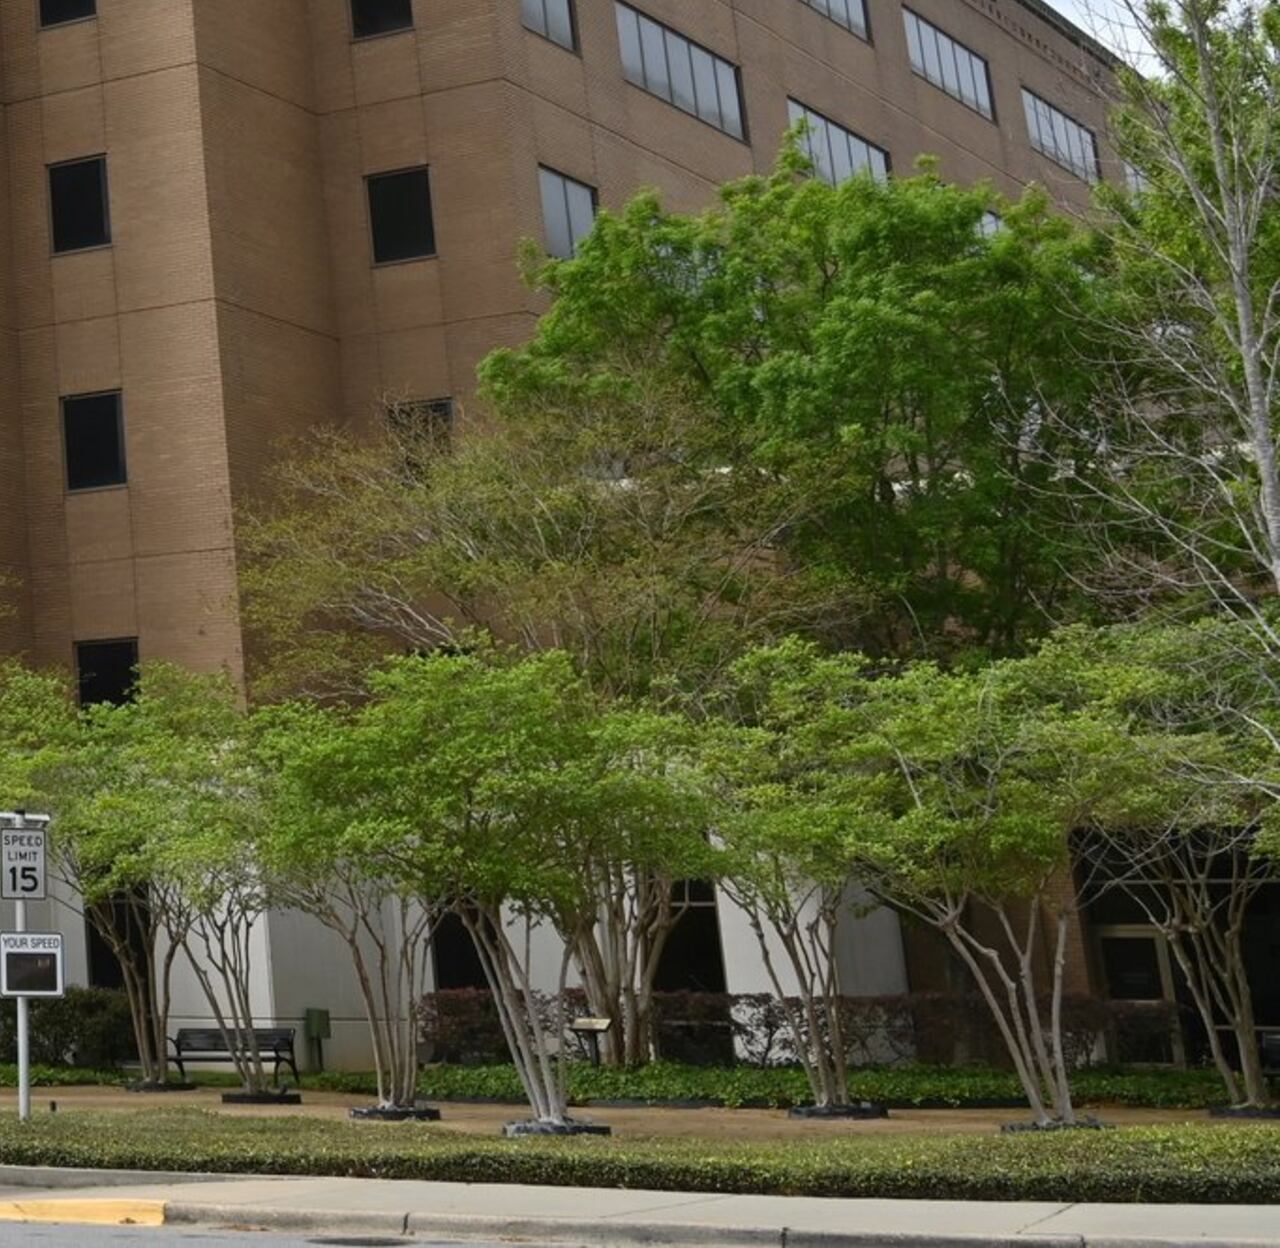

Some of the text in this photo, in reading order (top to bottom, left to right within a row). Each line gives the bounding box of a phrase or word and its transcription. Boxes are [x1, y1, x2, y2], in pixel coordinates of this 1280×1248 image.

[4, 835, 42, 847] SPEED
[8, 851, 37, 862] LIMIT
[9, 866, 39, 892] 15
[2, 937, 60, 948] YOUR SPEED
